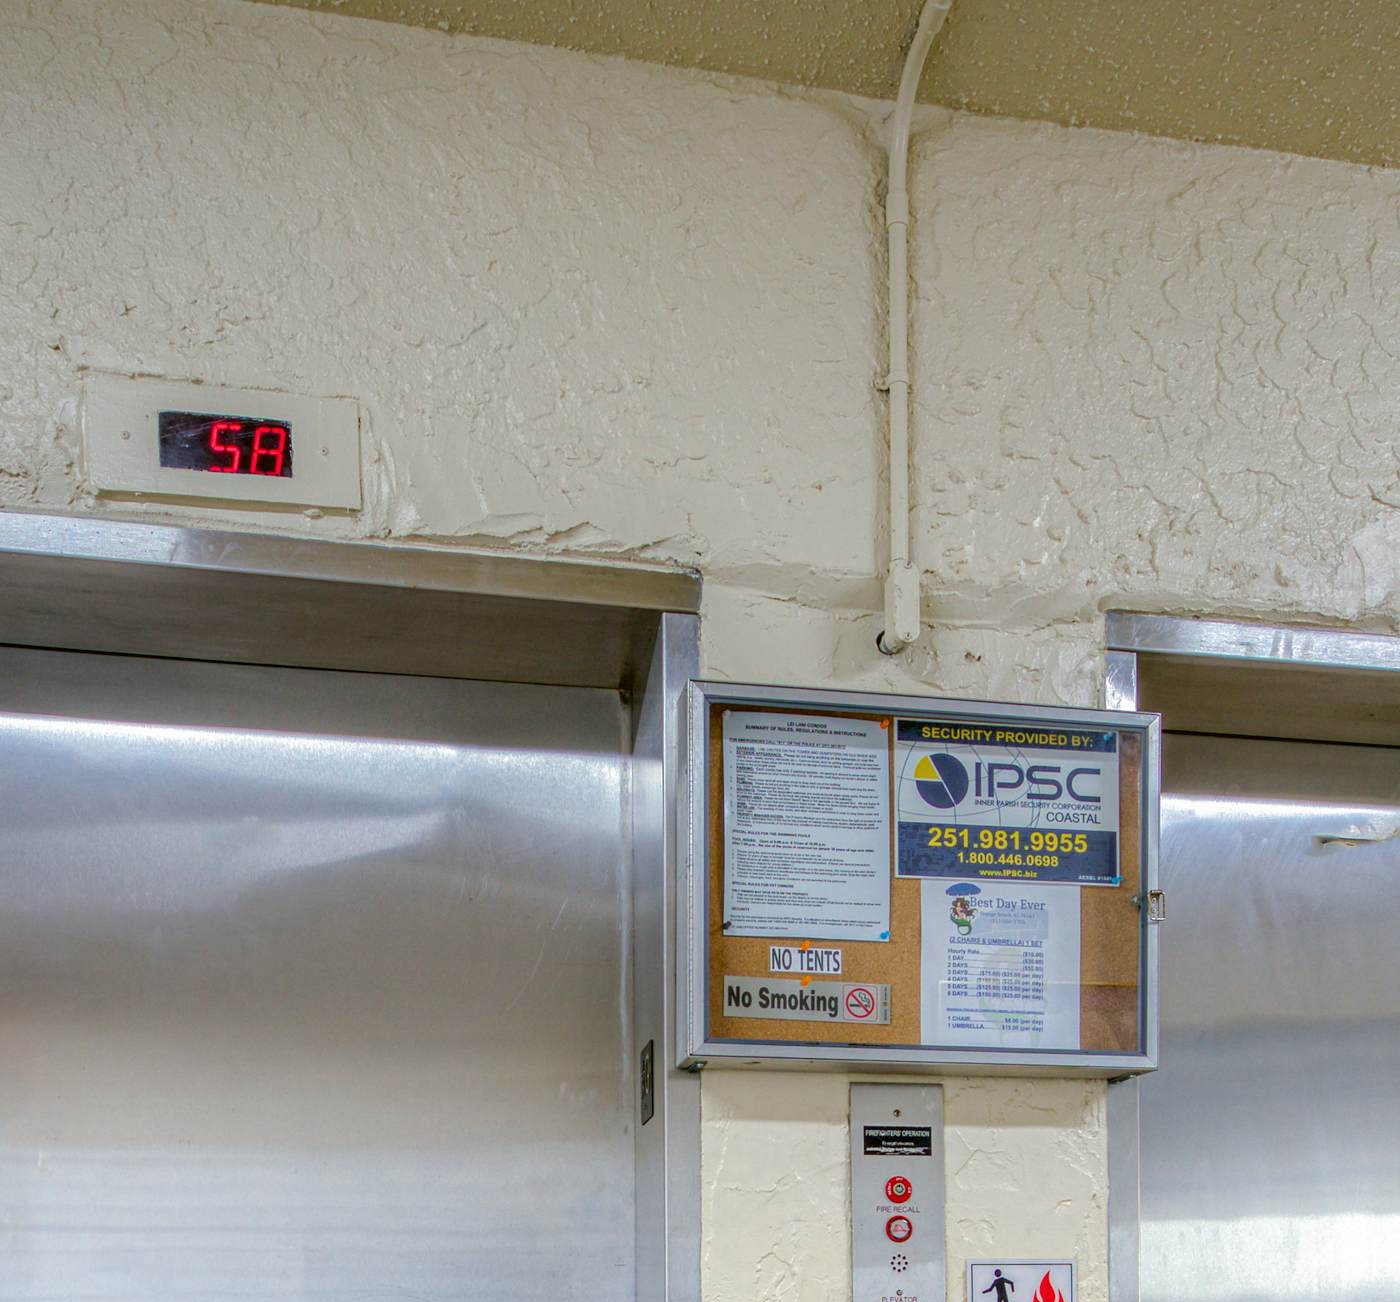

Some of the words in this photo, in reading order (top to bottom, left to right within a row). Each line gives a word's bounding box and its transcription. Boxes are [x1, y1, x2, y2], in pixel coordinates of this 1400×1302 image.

[921, 726, 993, 742] SECURITY
[996, 730, 1068, 746] PROVIDED
[975, 762, 1101, 802] IPSC
[975, 799, 995, 807] INNER
[1020, 801, 1051, 809] SECURITY
[1051, 802, 1101, 811] CORPORATION
[1046, 811, 1101, 824] COASTAL
[927, 827, 1088, 853] 251.981.9955
[957, 852, 1059, 867] 1.800.446.0698
[979, 869, 1038, 878] www.IPSC.biz
[970, 897, 994, 909] Best
[998, 899, 1016, 912] Day
[1020, 900, 1046, 911] Ever
[772, 948, 792, 970] NO
[798, 949, 840, 972] TENTS
[727, 985, 752, 1008] No
[758, 986, 839, 1018] Smoking
